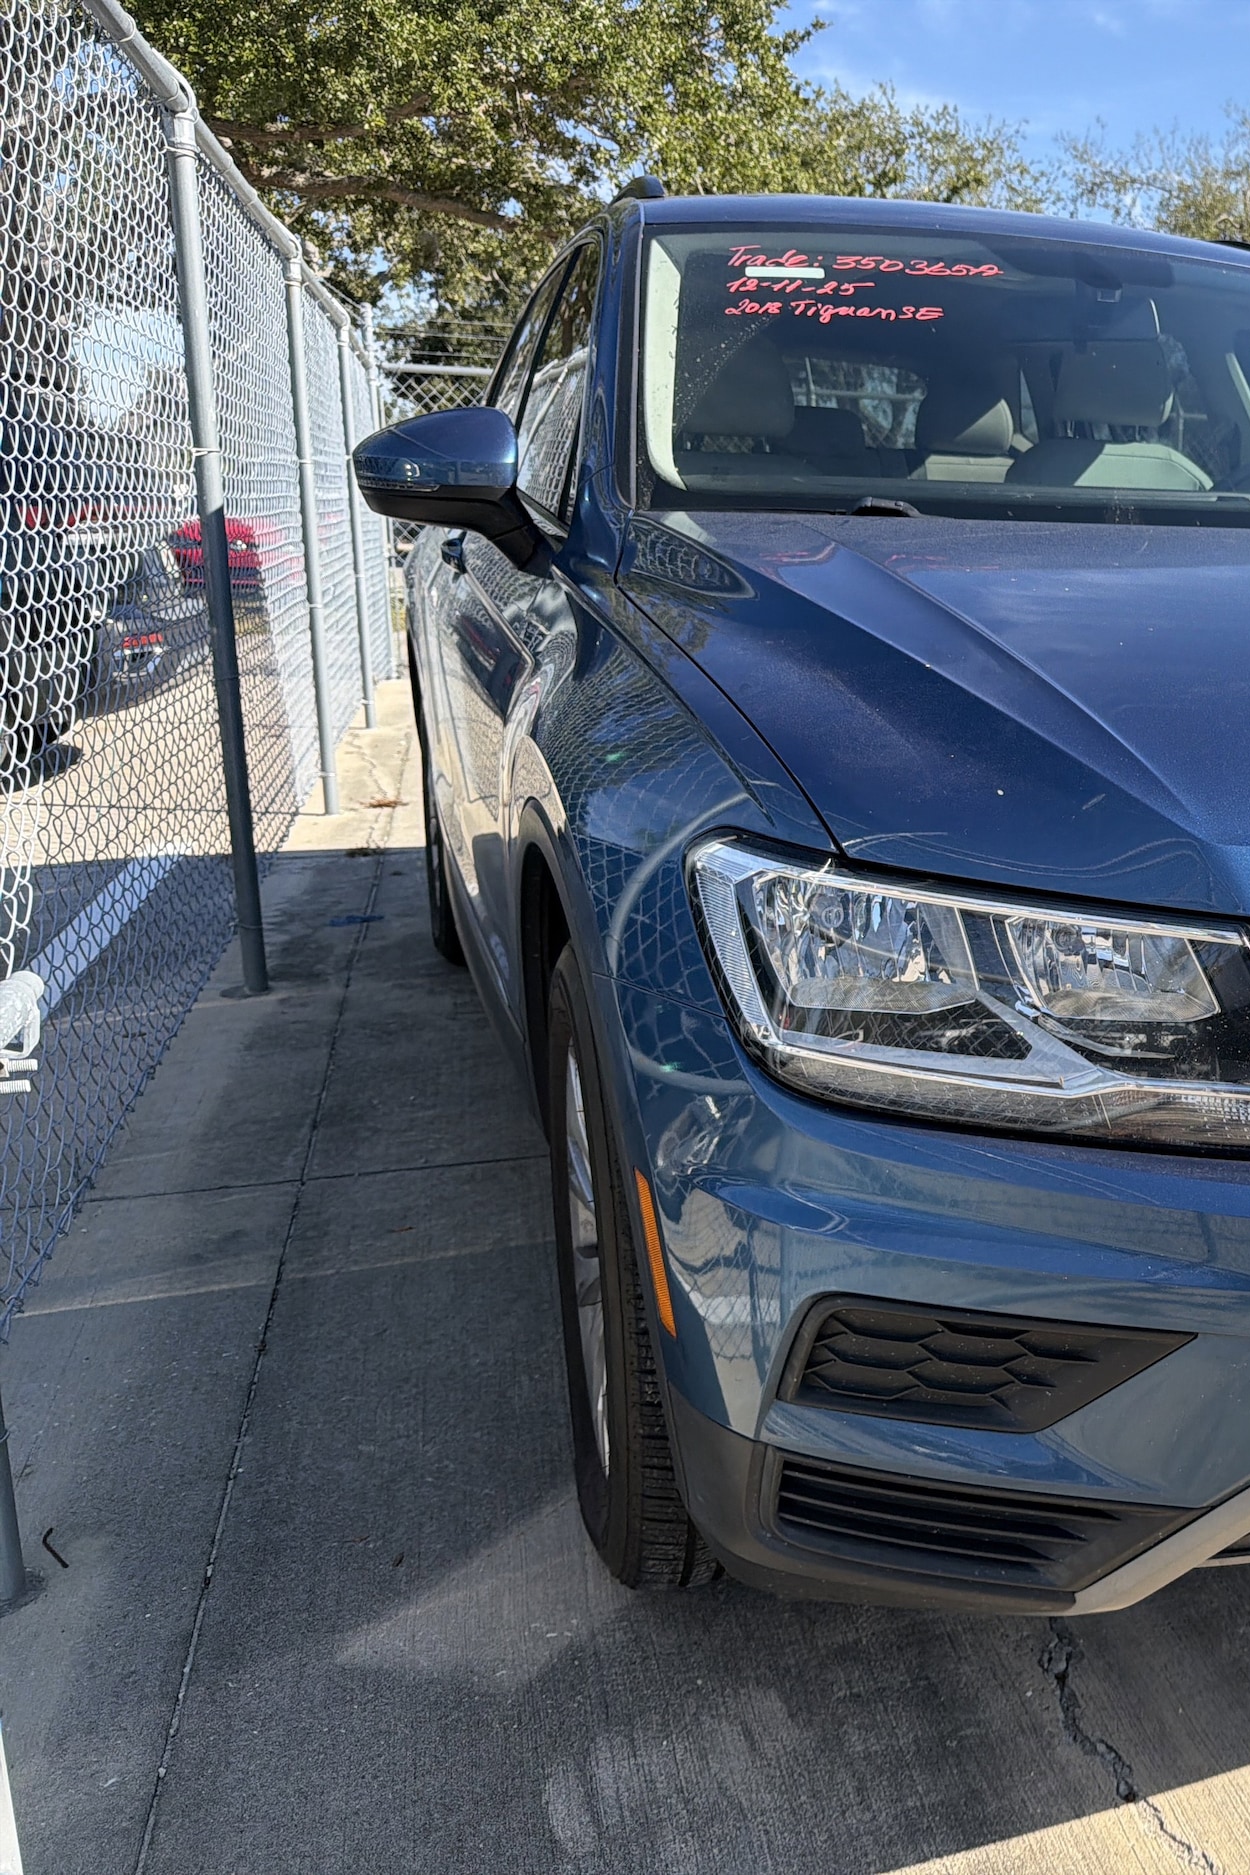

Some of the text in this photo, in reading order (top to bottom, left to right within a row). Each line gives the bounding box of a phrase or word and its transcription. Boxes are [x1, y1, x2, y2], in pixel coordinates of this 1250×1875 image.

[728, 245, 824, 267] Trade:
[726, 277, 875, 296] 12-11-25
[724, 299, 782, 315] 2018
